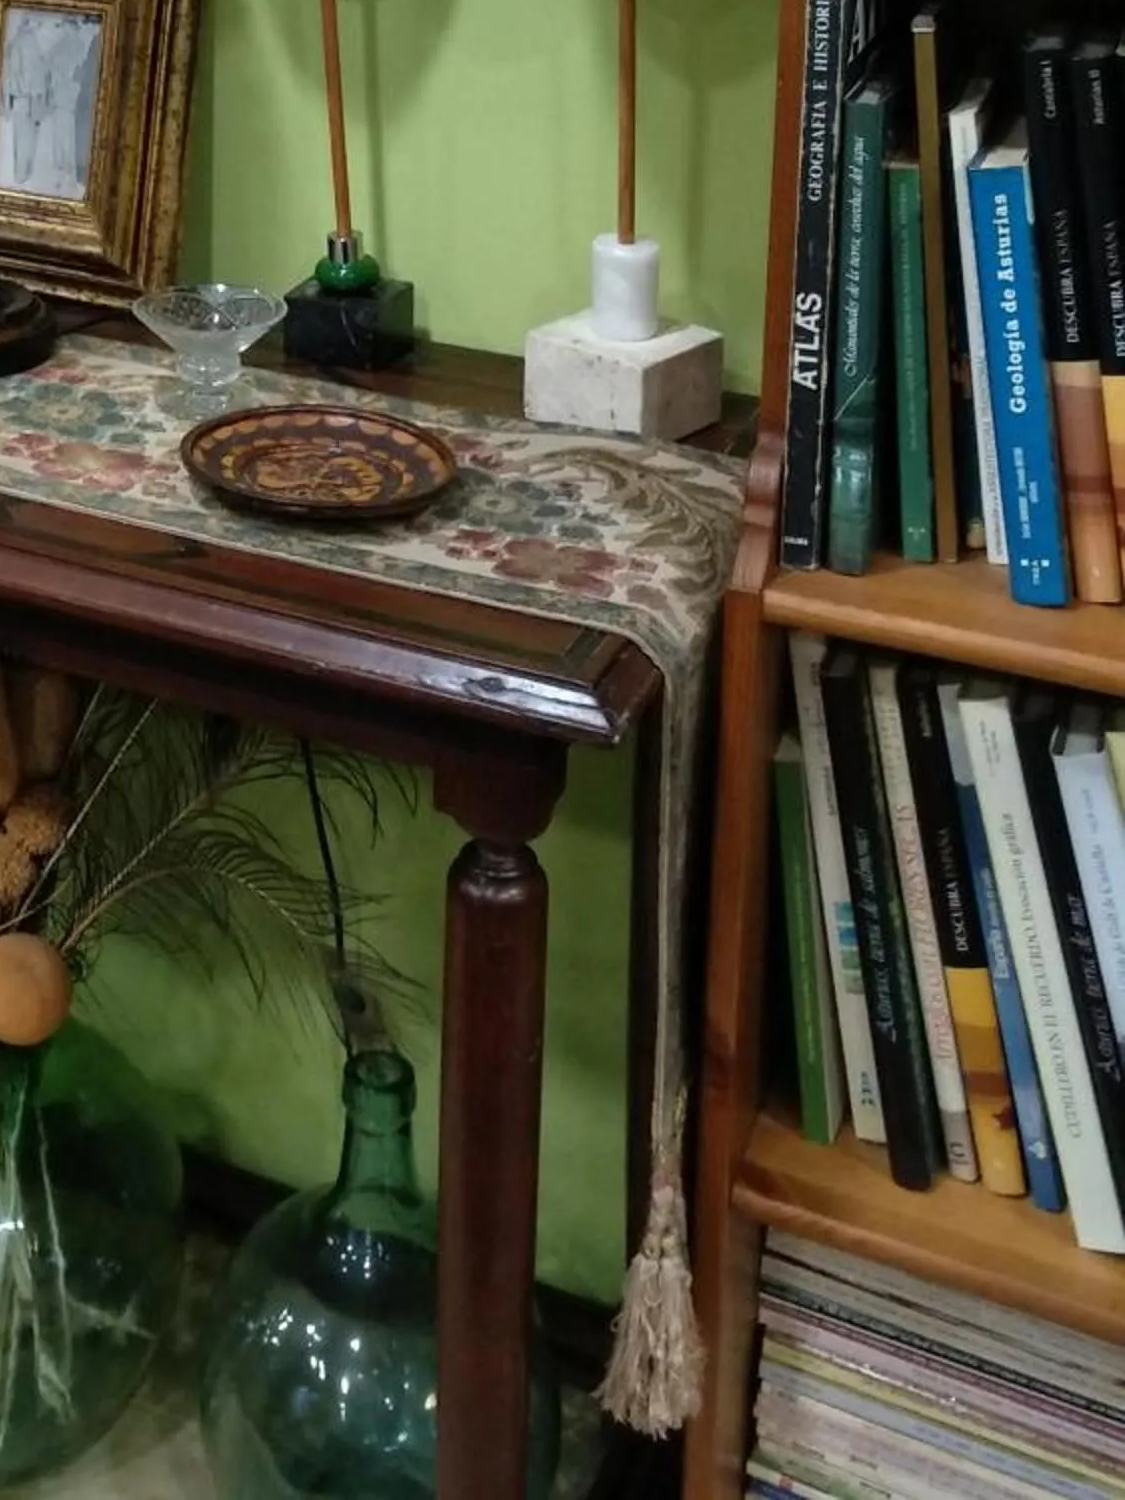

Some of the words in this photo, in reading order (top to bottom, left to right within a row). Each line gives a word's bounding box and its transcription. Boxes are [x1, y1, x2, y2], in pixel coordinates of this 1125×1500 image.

[812, 82, 828, 91] E
[807, 100, 828, 202] GEOGRAFIA
[993, 193, 1015, 283] Asturias
[1000, 288, 1018, 314] de
[1059, 266, 1081, 344] DESCUBRA
[1108, 279, 1125, 358] DESCUBRA
[793, 291, 823, 391] ATLAS
[1003, 318, 1027, 414] Geología
[946, 881, 970, 953] DESCUBRA
